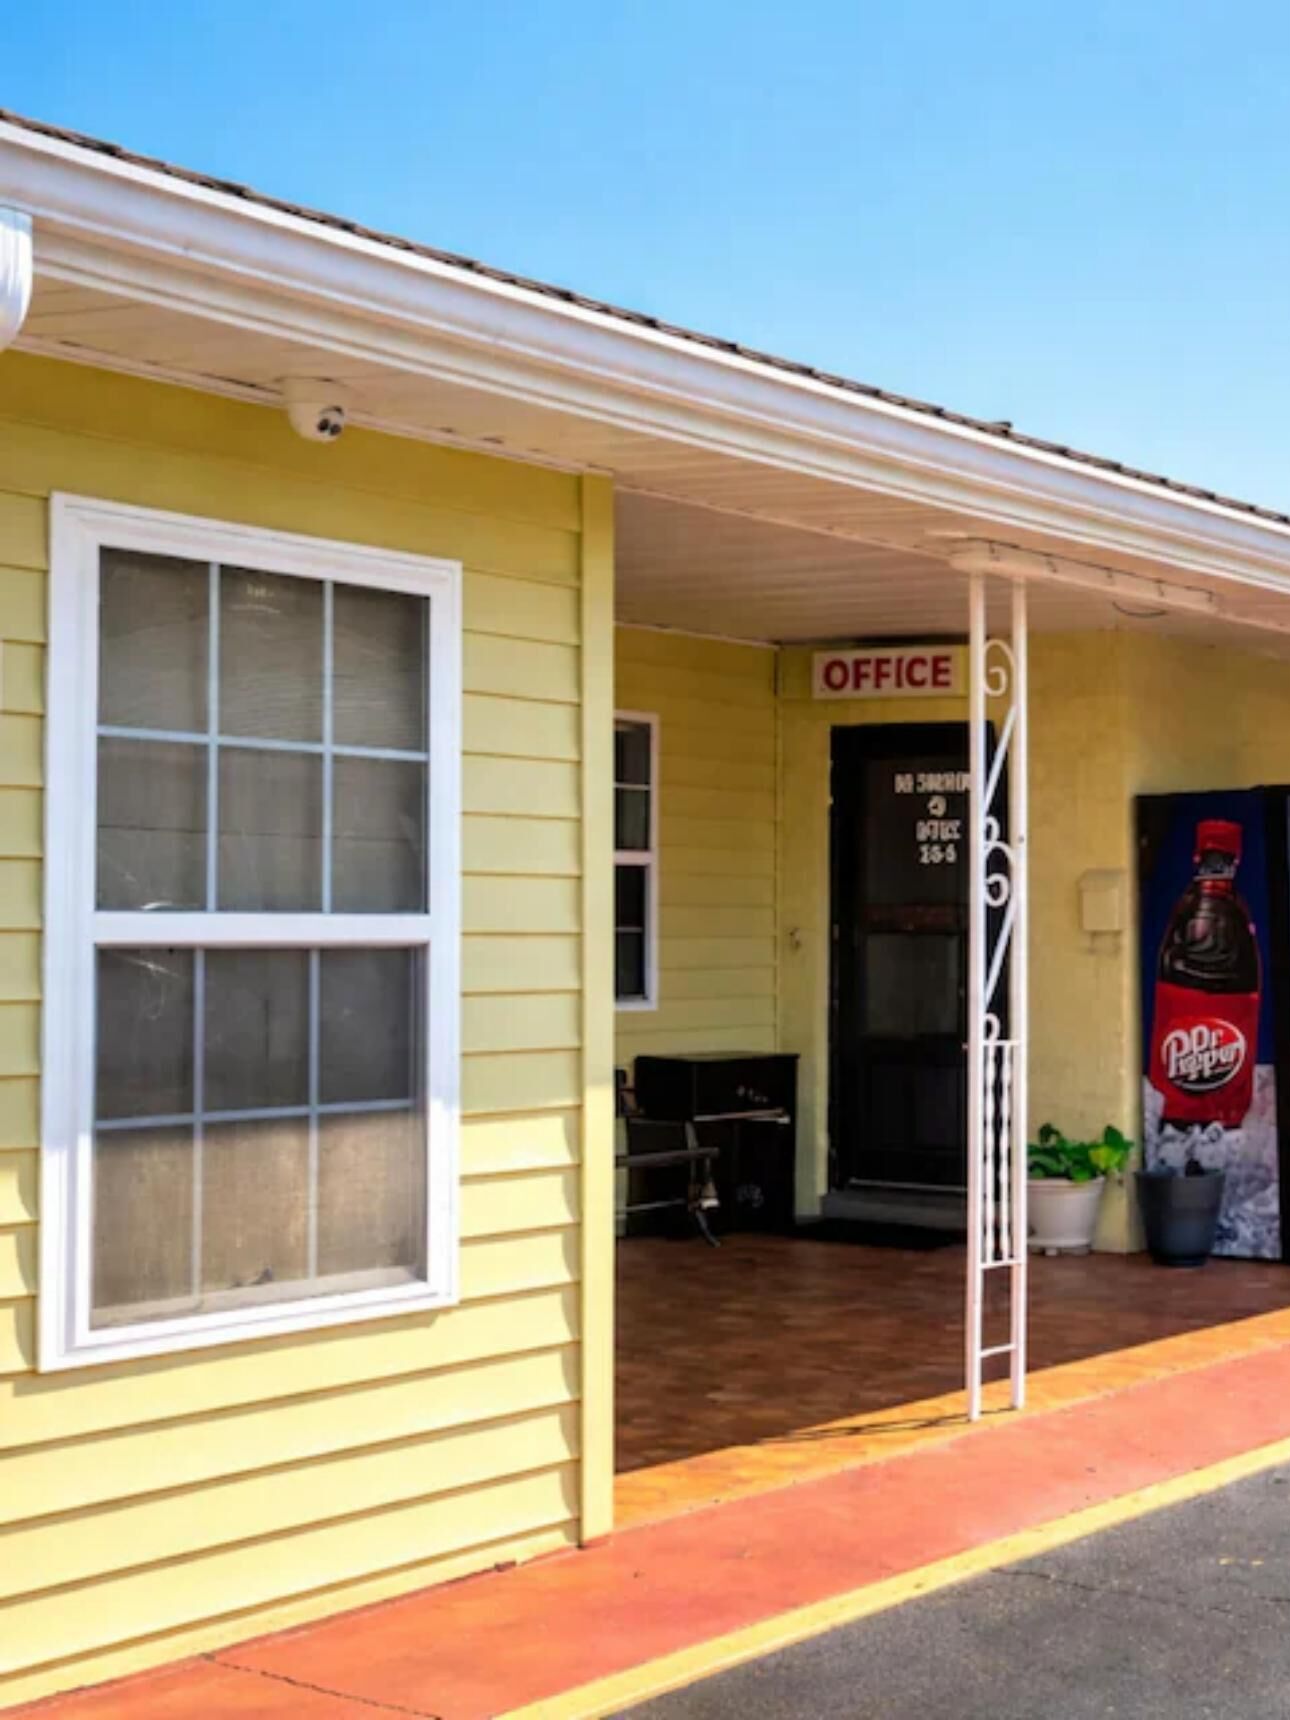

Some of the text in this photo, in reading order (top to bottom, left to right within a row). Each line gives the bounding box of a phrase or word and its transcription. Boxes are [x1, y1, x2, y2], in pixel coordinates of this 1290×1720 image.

[823, 655, 952, 691] OFFICE
[1162, 1029, 1243, 1081] Pepper
[1190, 1024, 1224, 1055] Dr
